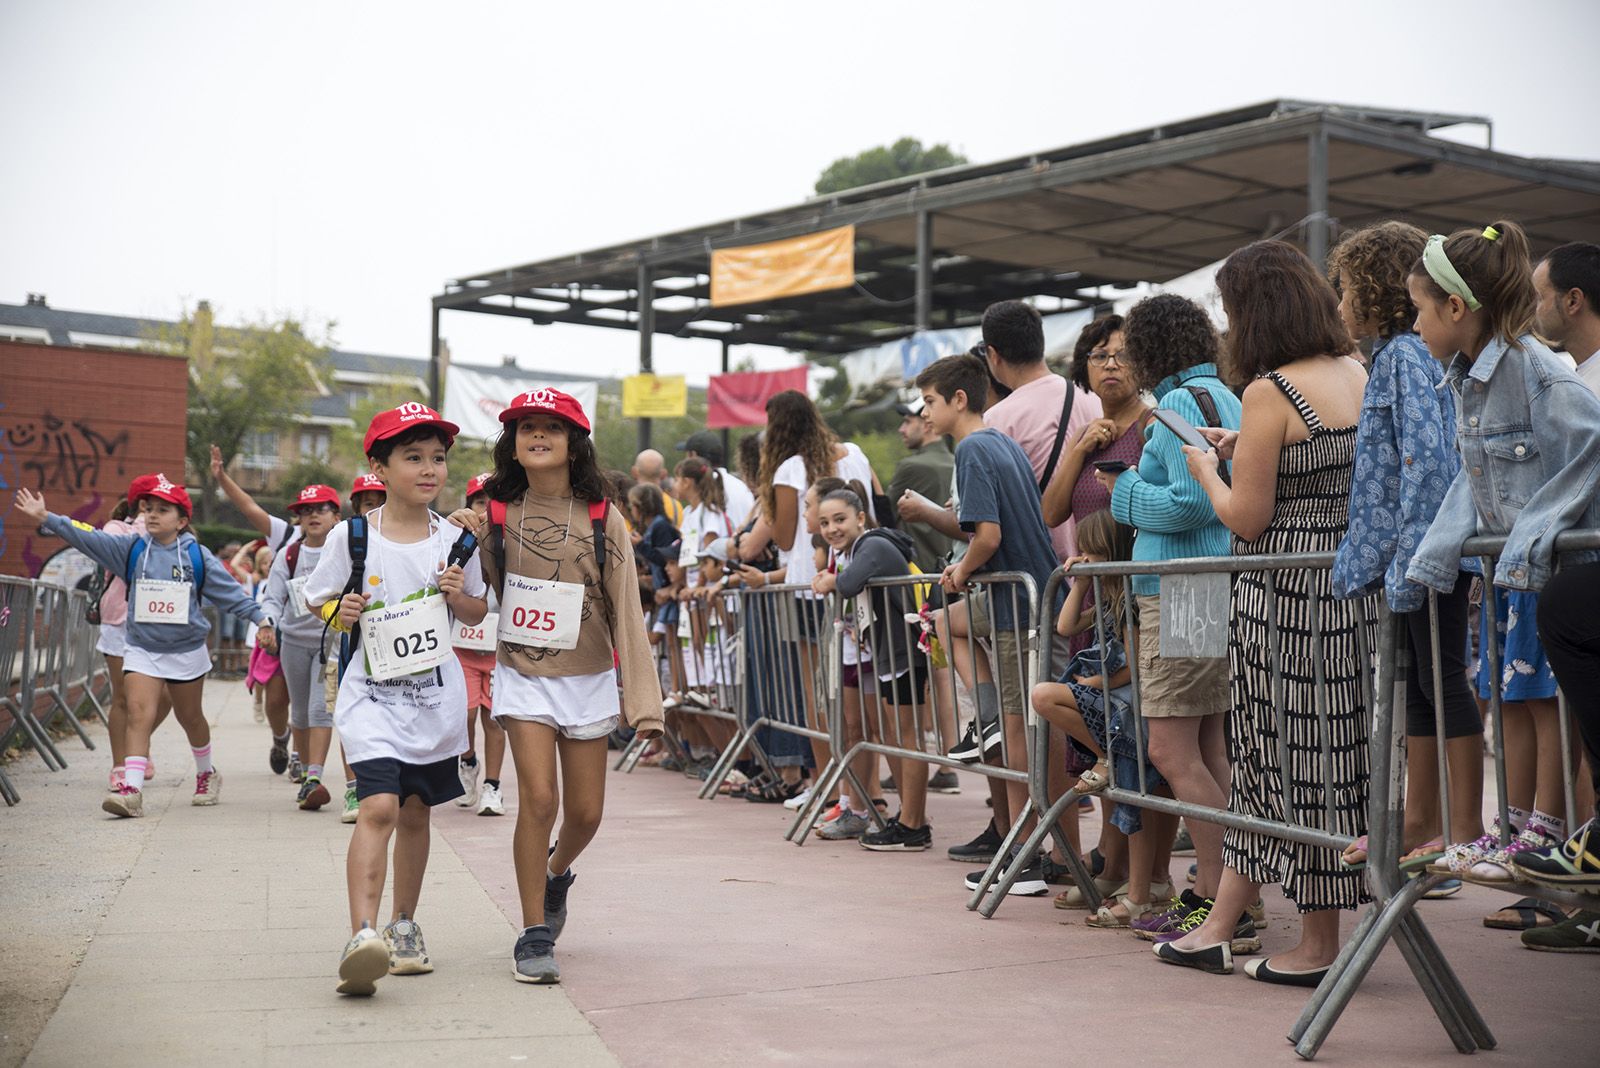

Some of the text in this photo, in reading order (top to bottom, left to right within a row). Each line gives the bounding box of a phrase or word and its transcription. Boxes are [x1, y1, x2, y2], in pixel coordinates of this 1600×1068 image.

[526, 389, 557, 402] TOT
[395, 402, 429, 415] TOT
[148, 601, 175, 614] 026
[512, 607, 556, 632] 025
[460, 627, 484, 640] 024
[393, 629, 439, 658] 025
